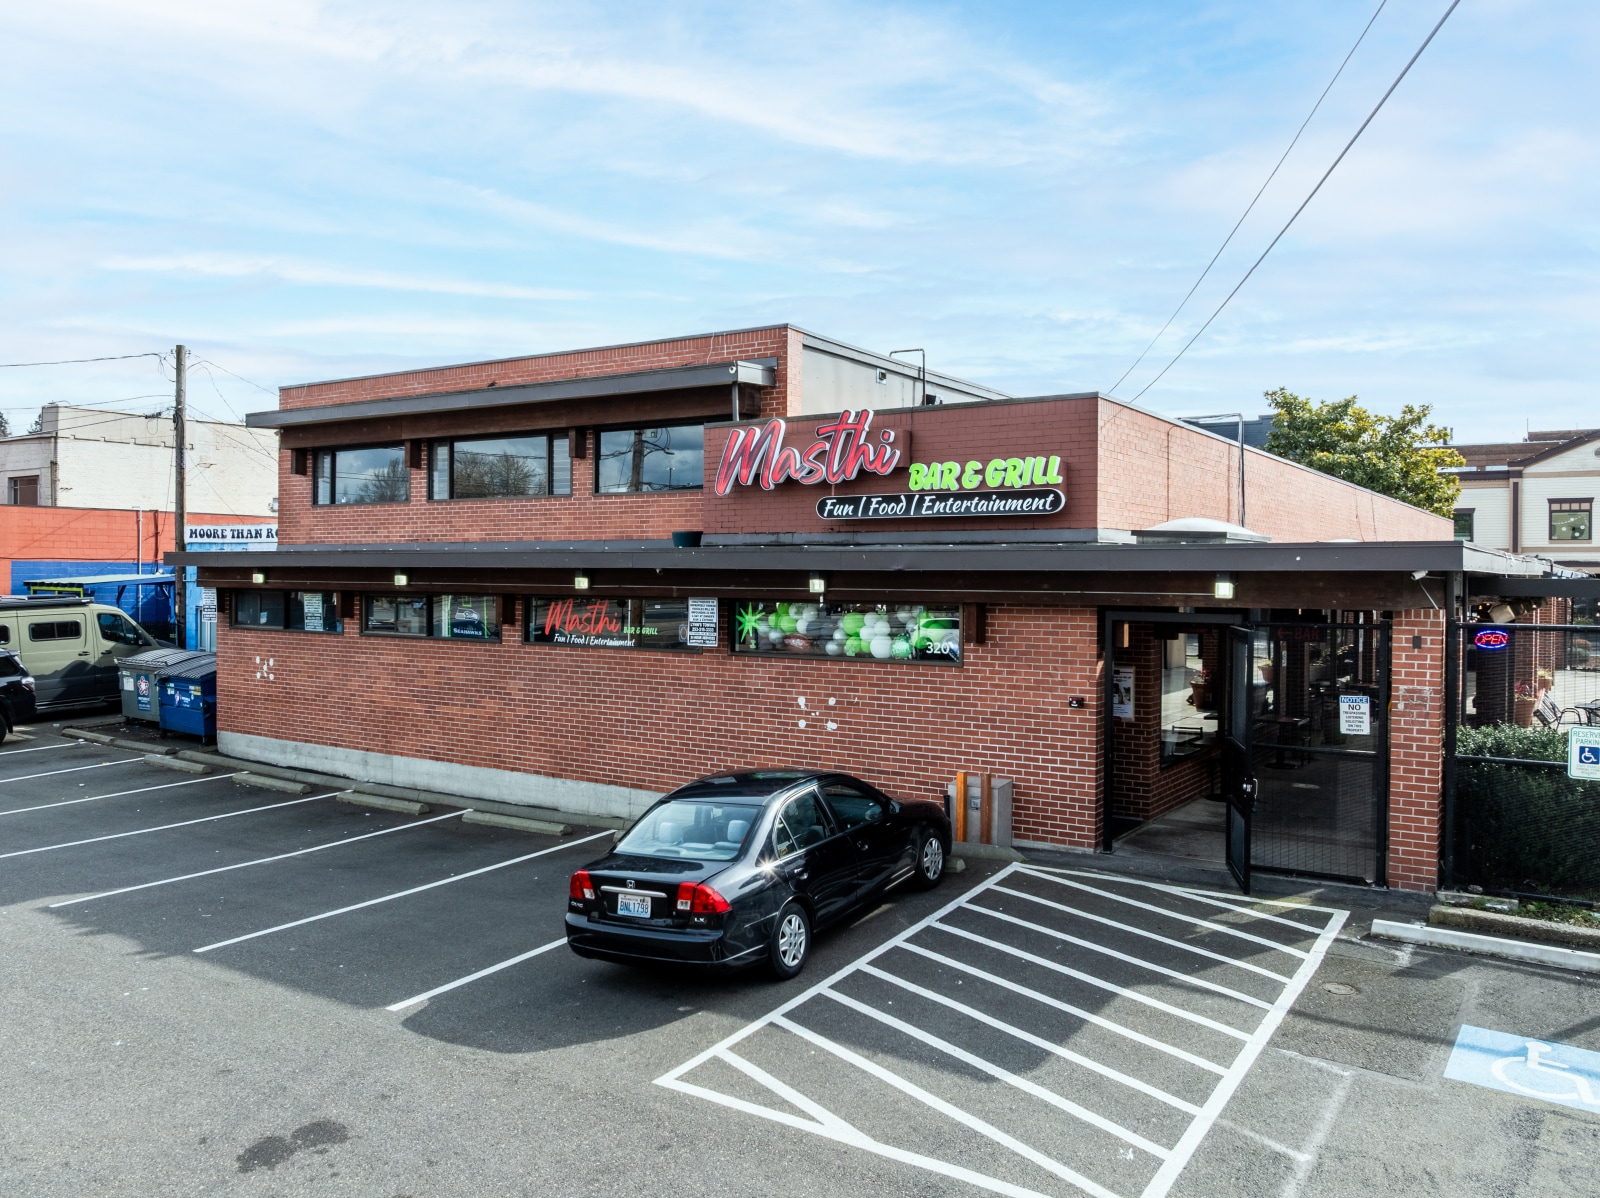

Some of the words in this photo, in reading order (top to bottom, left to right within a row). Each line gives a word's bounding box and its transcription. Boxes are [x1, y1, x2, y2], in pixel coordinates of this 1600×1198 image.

[715, 409, 900, 496] Masthi
[909, 461, 961, 491] BAR
[961, 460, 983, 489] &
[985, 455, 1063, 488] GRILL
[823, 499, 854, 517] Fun
[869, 495, 907, 516] Food
[921, 494, 1054, 515] Entertainment
[189, 528, 227, 539] MOORE
[230, 528, 262, 539] THAN
[545, 599, 621, 635] Masthi
[623, 626, 635, 634] BAR
[642, 627, 658, 635] GRILL
[554, 634, 566, 642] Fun
[570, 634, 585, 644] Food
[589, 636, 636, 647] Entertainment
[1474, 633, 1509, 645] OPEN
[926, 642, 950, 654] 320
[620, 900, 649, 914] BNL1798
